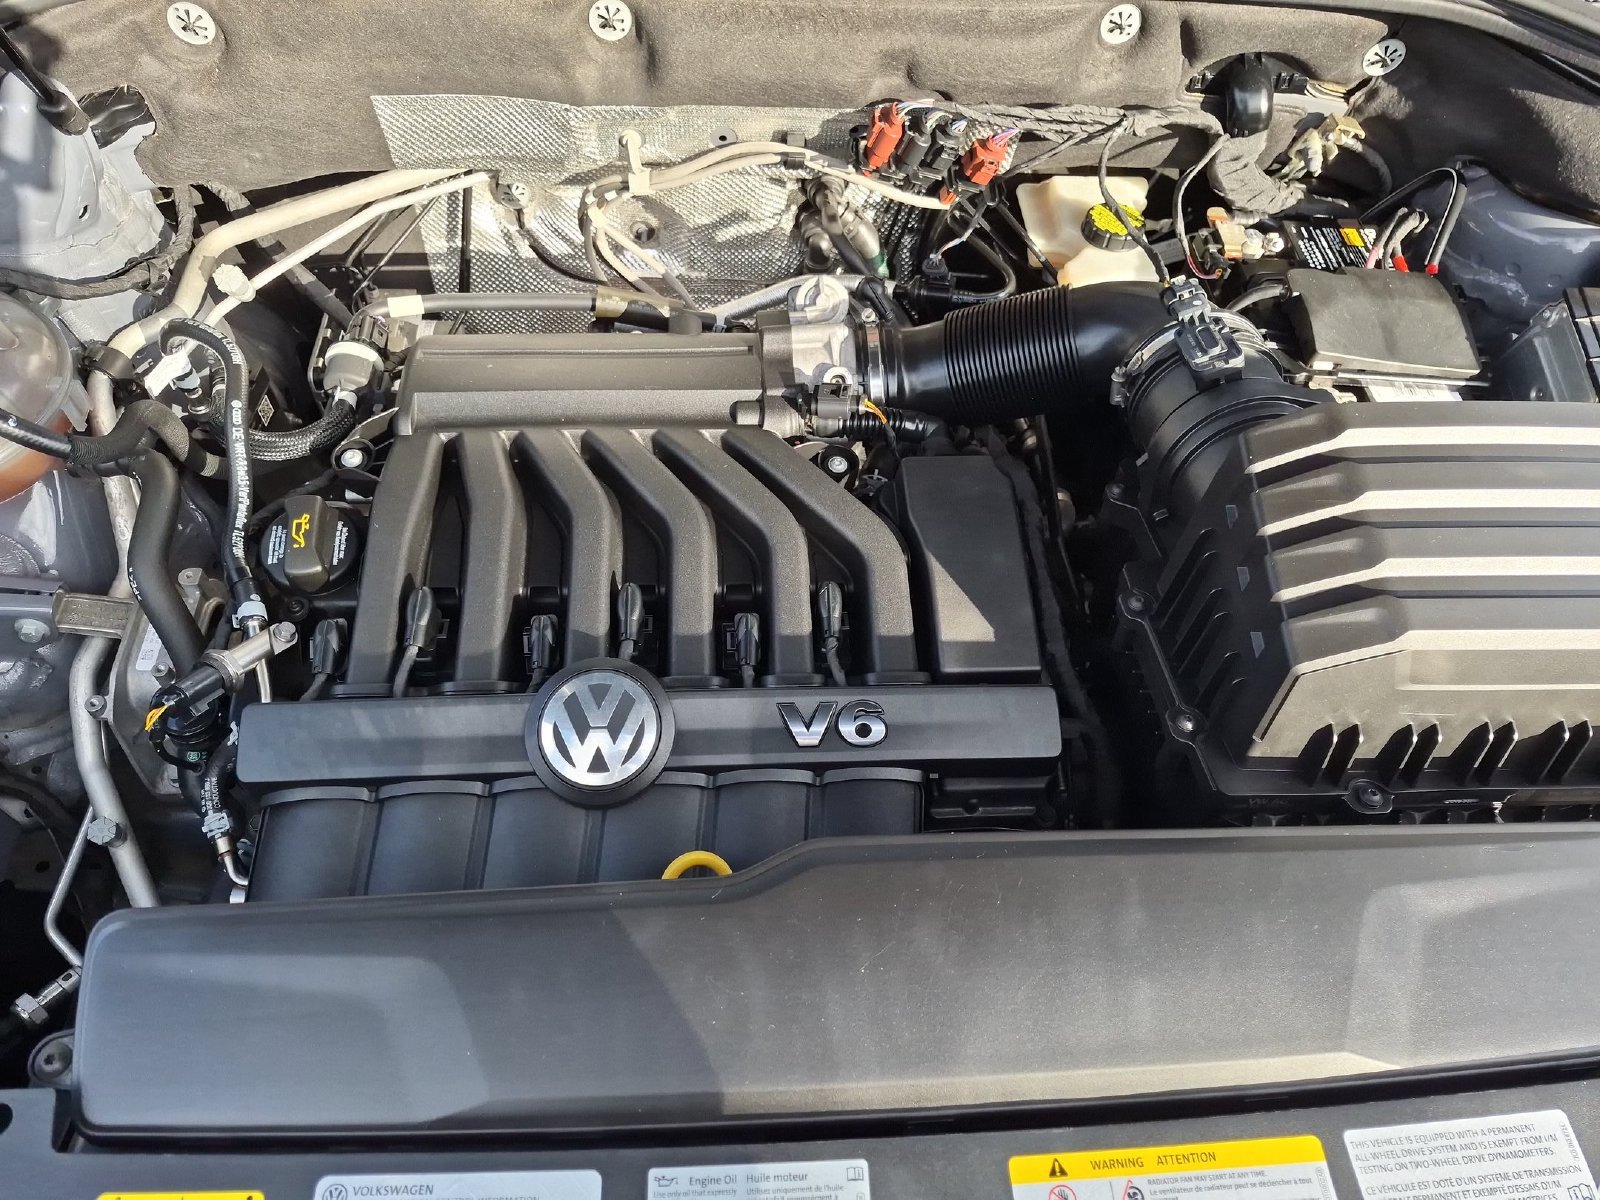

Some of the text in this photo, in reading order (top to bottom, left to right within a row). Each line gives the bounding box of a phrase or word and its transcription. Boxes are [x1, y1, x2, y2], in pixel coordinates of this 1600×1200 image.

[776, 700, 888, 748] V6
[1350, 1141, 1369, 1149] THIS
[1370, 1137, 1404, 1147] VEHICLE
[1405, 1137, 1413, 1145] IS
[1414, 1131, 1455, 1144] EQUIPPED
[1456, 1130, 1479, 1139] WITH
[1488, 1124, 1536, 1135] PERMANENT
[1402, 1147, 1428, 1157] DRIVE
[1428, 1143, 1458, 1155] SYSTEM
[1459, 1142, 1477, 1151] AND
[1480, 1142, 1487, 1150] IS
[1488, 1139, 1519, 1149] EXEMPT
[1520, 1136, 1542, 1146] FROM
[1090, 1151, 1217, 1171] WARNING ATTENTION
[1359, 1163, 1394, 1175] TESTING
[1394, 1162, 1408, 1171] ON
[1409, 1158, 1461, 1170] TWO-WHEEL
[1462, 1154, 1487, 1164] DRIVE
[689, 1175, 737, 1188] Engine Oil
[746, 1172, 808, 1184] Huile moteur
[1148, 1177, 1178, 1185] RADIATOR
[1208, 1173, 1227, 1181] START
[1366, 1187, 1376, 1196] CE
[1417, 1181, 1430, 1190] EST
[1432, 1178, 1455, 1188] DOTÉ
[1456, 1176, 1476, 1186] D'UN
[1512, 1171, 1523, 1180] DE
[1524, 1165, 1581, 1178] TRANSMISSION
[353, 1184, 434, 1196] VOLKSWAGEN
[667, 1190, 681, 1198] only
[772, 1186, 812, 1195] uniquement
[1160, 1187, 1193, 1195] ventilateur
[1204, 1184, 1233, 1192] radiateur
[1235, 1182, 1249, 1190] peut
[1462, 1190, 1470, 1199] ET
[1472, 1185, 1507, 1198] EXEMPTÉ
[1508, 1182, 1540, 1194] D'ESSAIS
